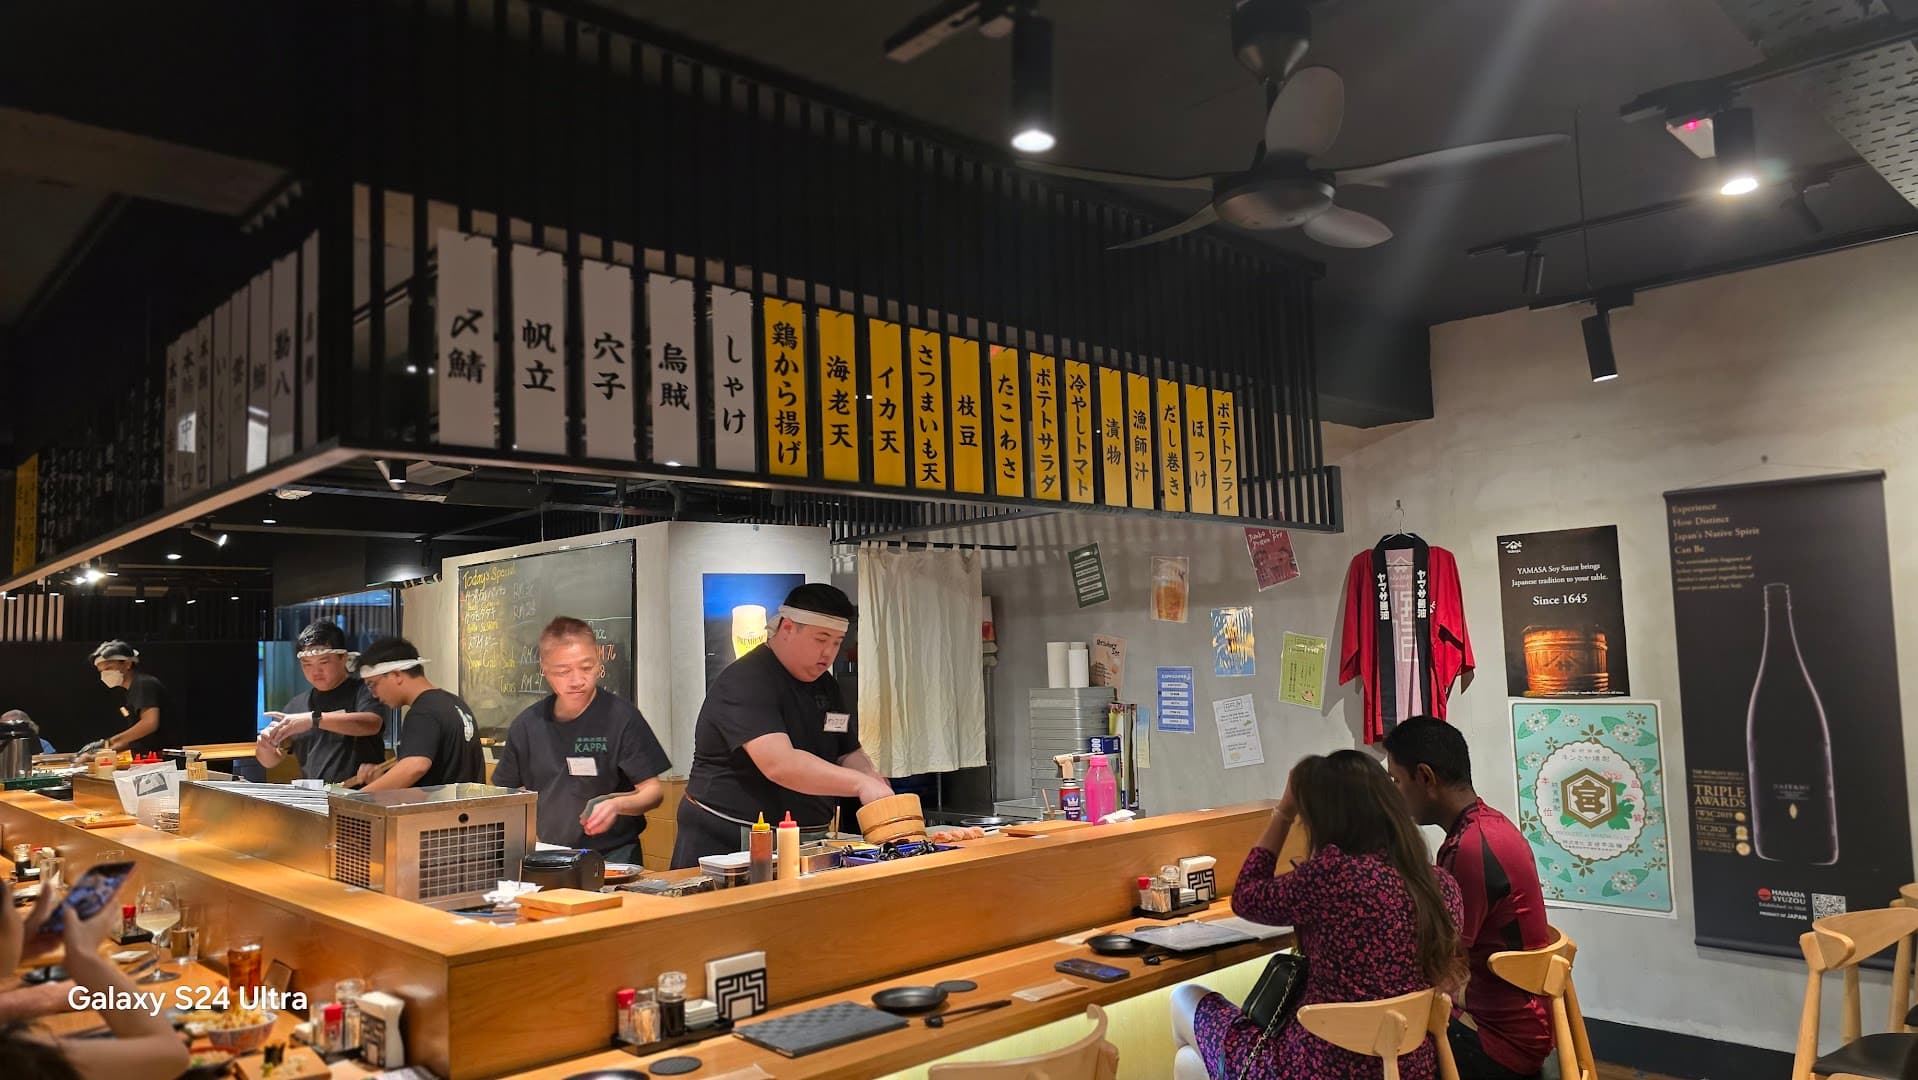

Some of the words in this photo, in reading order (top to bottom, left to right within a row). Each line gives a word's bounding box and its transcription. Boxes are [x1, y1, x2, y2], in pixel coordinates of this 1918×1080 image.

[447, 308, 487, 384] 〆鯖
[521, 318, 557, 394] 帆立
[592, 332, 627, 401] 穴子
[658, 342, 691, 411] 烏賊
[771, 320, 802, 466] 鶏から揚げ
[826, 355, 854, 449] 海老天
[877, 366, 901, 454] イカ天
[917, 344, 942, 484] さつまいも天
[956, 394, 979, 449] 枝豆
[996, 374, 1018, 480] たこわさ
[1035, 367, 1057, 494] ポテトサラダ
[1069, 373, 1090, 498] 冷やしトマト
[1105, 417, 1122, 466] 漬物
[1132, 409, 1150, 482] 漁師汁
[1163, 403, 1182, 497] だし巻き
[1191, 420, 1208, 489] ほっけ
[1216, 402, 1234, 512] ポテトフライ
[1672, 503, 1717, 515] Experience
[1673, 518, 1693, 528] How
[1695, 516, 1729, 526] Distinct
[1673, 532, 1703, 542] Japan's
[1704, 530, 1733, 538] Native
[1734, 527, 1760, 538] Spirit
[1511, 579, 1538, 588] Japanese
[1538, 577, 1566, 585] tradition
[1574, 576, 1590, 584] your
[1516, 566, 1548, 575] YAMASA
[1548, 565, 1560, 574] Soy
[1560, 563, 1580, 572] Sauce
[1673, 546, 1692, 554] Can
[1694, 545, 1705, 553] Be
[1532, 595, 1560, 606] Since
[1561, 593, 1588, 605] 1645
[574, 743, 608, 753] KAPPA
[1693, 784, 1745, 798] TRIPLE
[1694, 796, 1747, 809] AWARDS
[1772, 888, 1806, 898] HAMADA
[1772, 896, 1806, 905] SYUZOU
